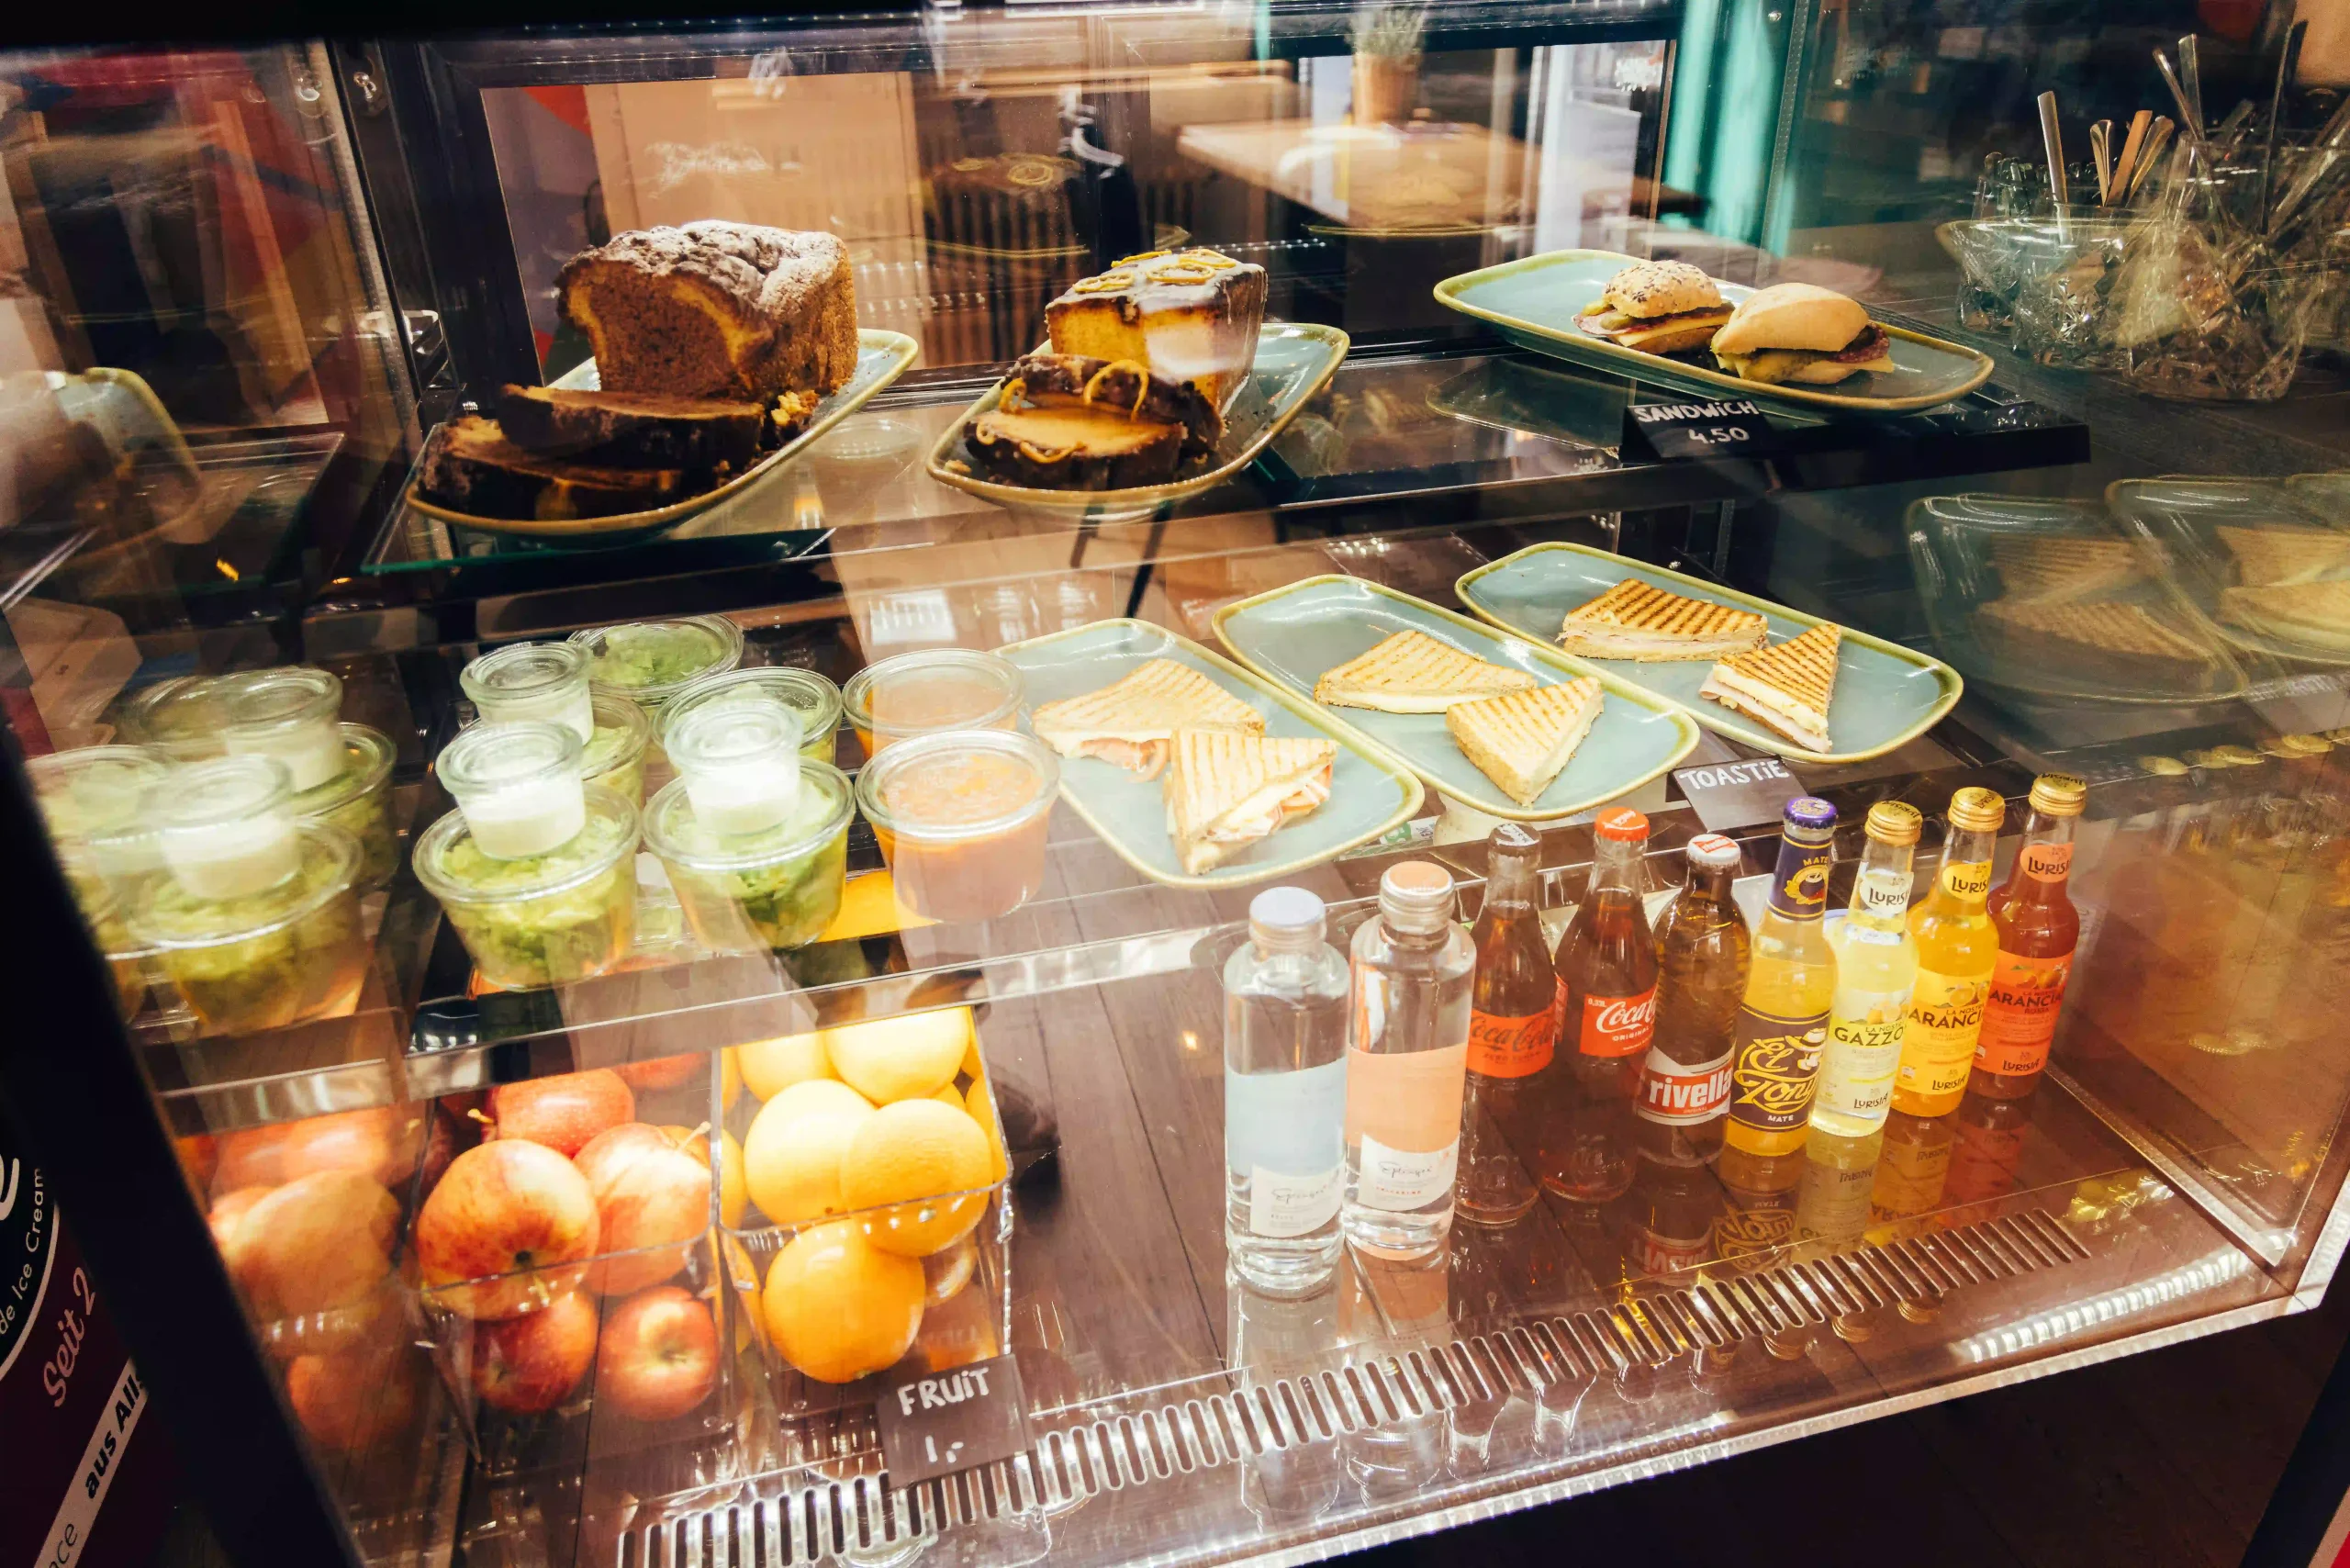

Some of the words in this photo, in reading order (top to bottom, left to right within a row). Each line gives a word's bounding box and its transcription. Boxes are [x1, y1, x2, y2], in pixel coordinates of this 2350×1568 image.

[1688, 427, 1750, 444] 4.50
[1803, 856, 1830, 867] MATE
[1612, 1025, 1651, 1042] ORIGINAL
[1834, 1026, 1905, 1047] GAZZO
[1649, 1065, 1734, 1109] rivella
[1767, 1114, 1796, 1123] MATE
[12, 1262, 33, 1300] Ice
[26, 1167, 44, 1253] Cream
[43, 1308, 85, 1408] Seit
[73, 1266, 96, 1316] 2
[85, 1430, 118, 1499] aus
[115, 1374, 144, 1434] All
